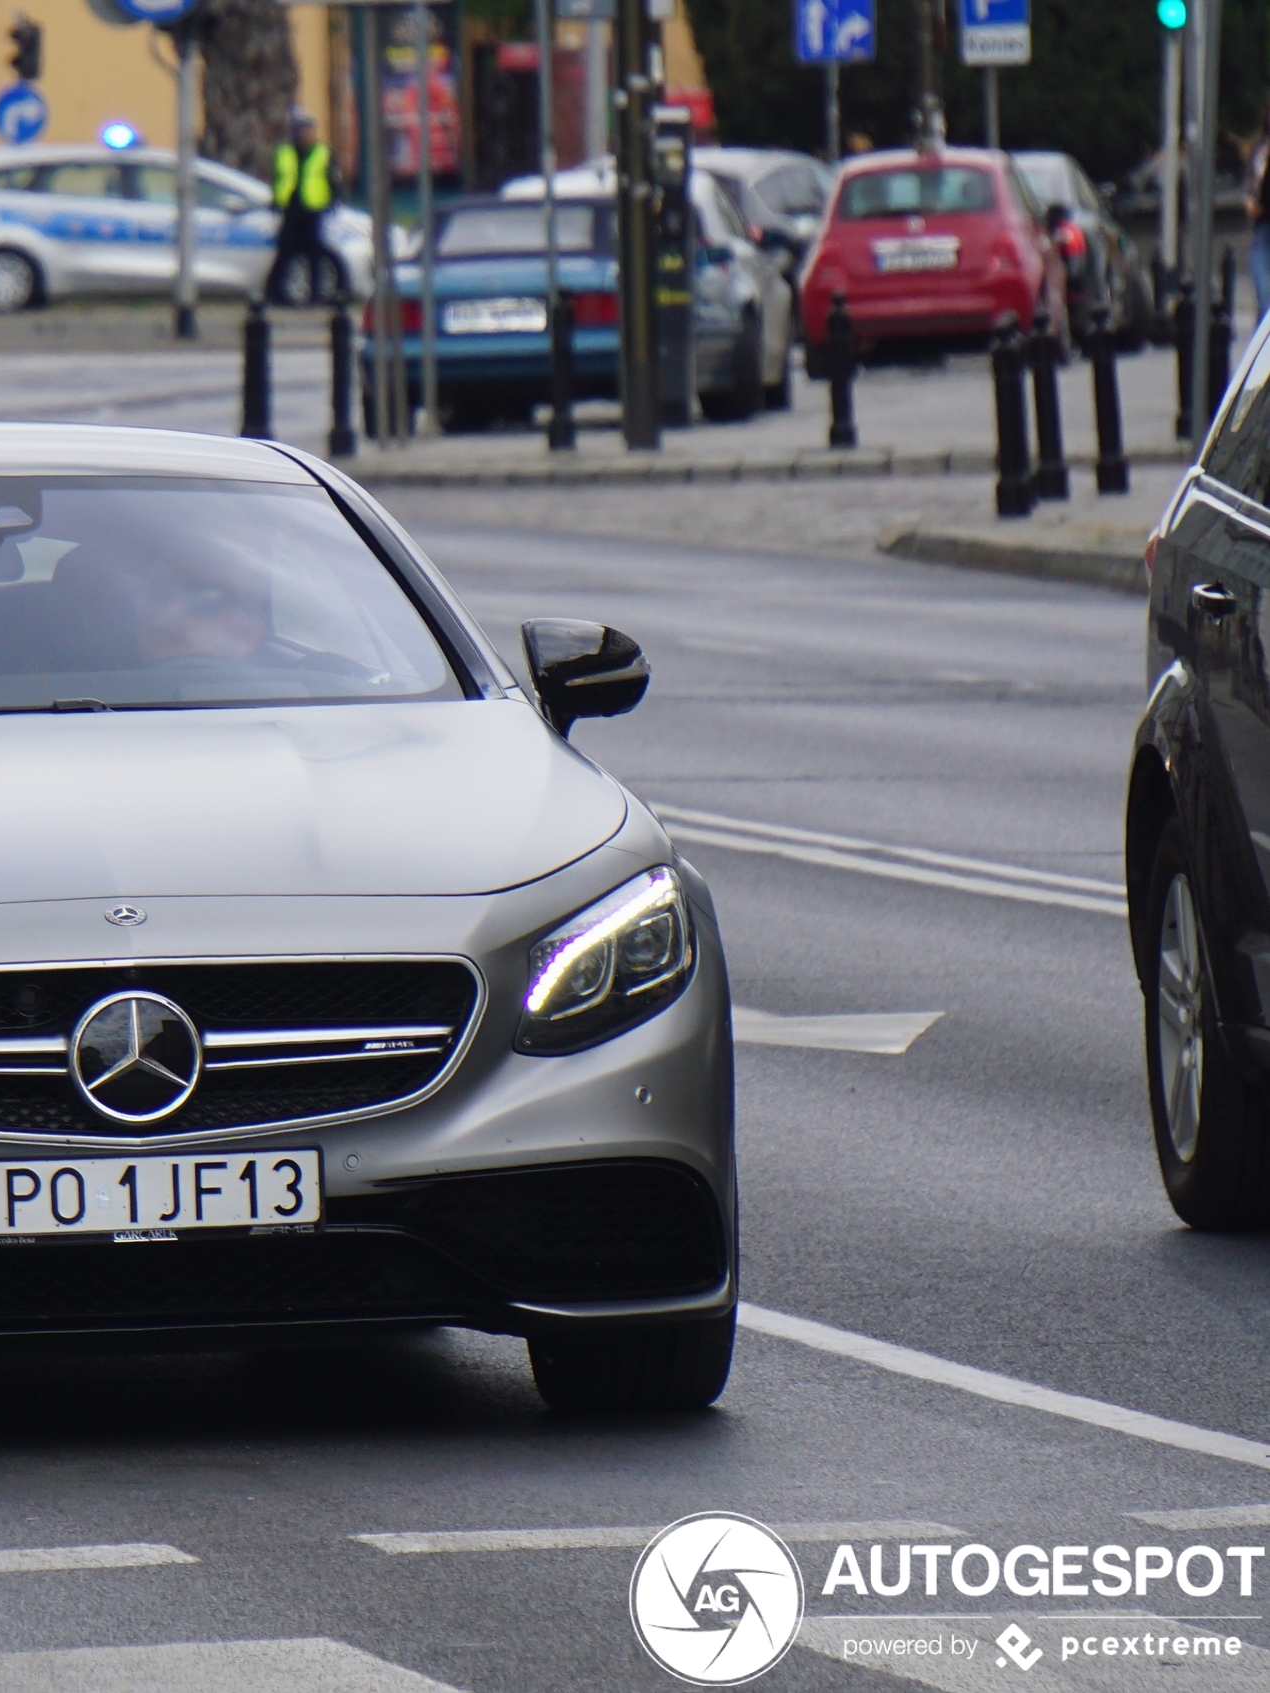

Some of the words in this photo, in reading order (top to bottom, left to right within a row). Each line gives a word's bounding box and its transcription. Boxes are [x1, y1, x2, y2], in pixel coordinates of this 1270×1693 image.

[6, 1166, 86, 1227] PO
[118, 1158, 304, 1224] 1JF13
[271, 1224, 315, 1234] AMG
